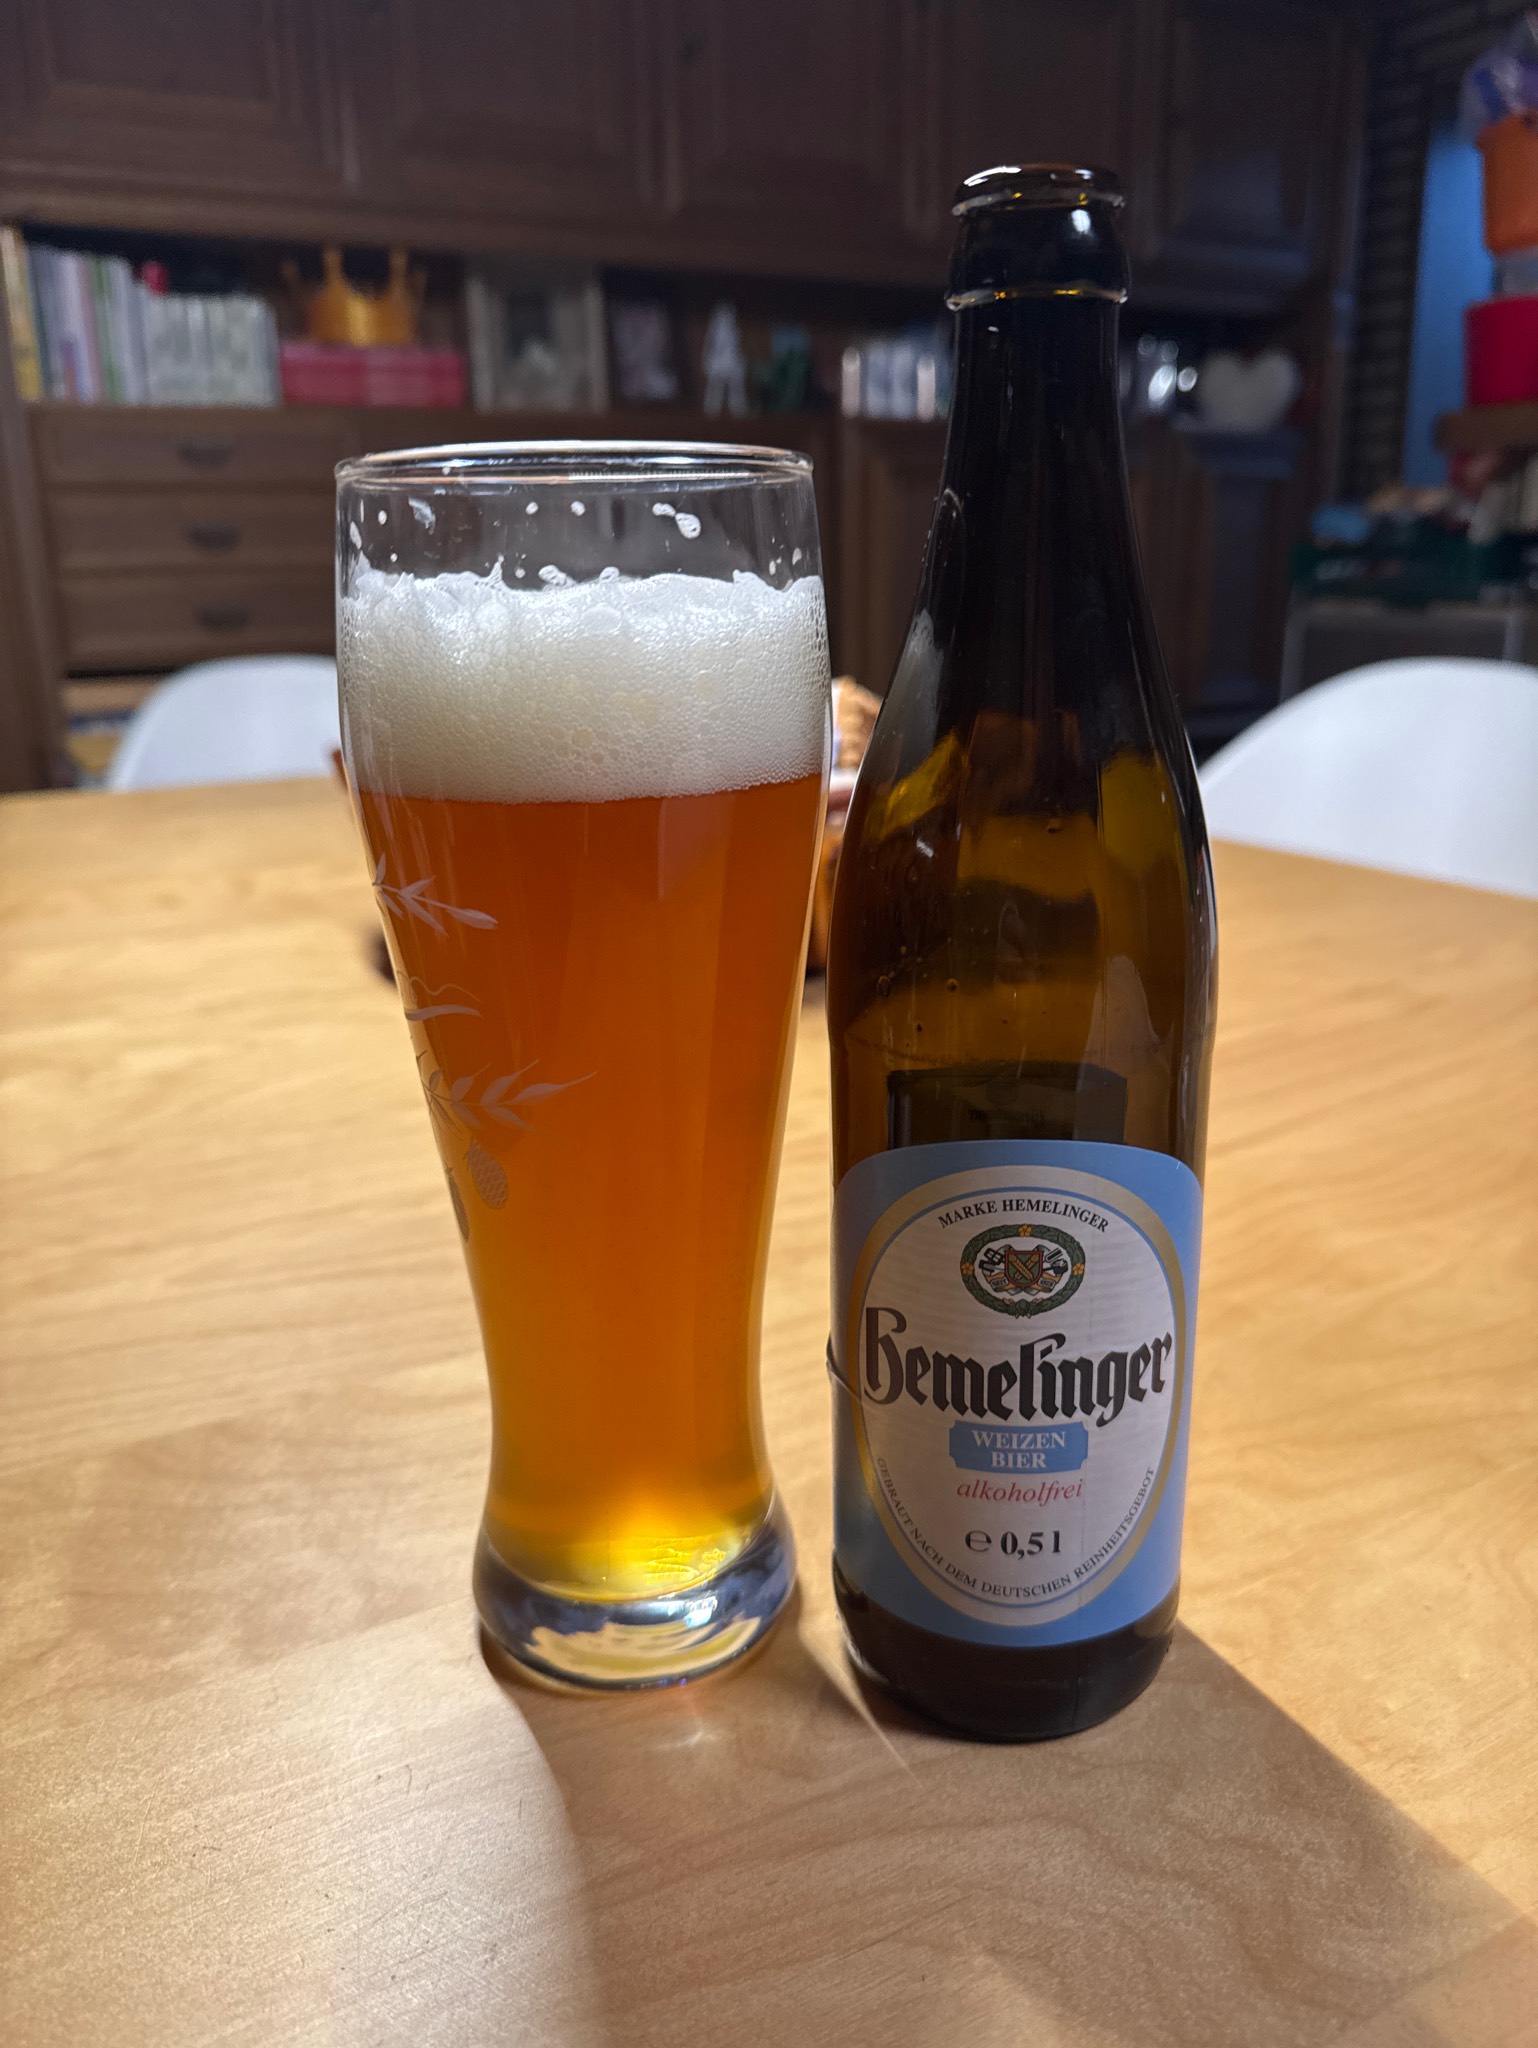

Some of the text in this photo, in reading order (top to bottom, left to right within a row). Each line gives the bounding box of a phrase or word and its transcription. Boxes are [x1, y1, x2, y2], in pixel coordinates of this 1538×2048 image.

[938, 1199, 1109, 1233] MARKE HEMELINGER
[864, 1307, 1172, 1428] Hemelinger
[971, 1430, 1066, 1450] WEIZEN
[991, 1451, 1047, 1468] BIER
[956, 1478, 1084, 1507] alkoholfrei
[877, 1457, 1155, 1598] GEBRAUT NACH DEM DEUTSCHEN REINHEITSGEBOT
